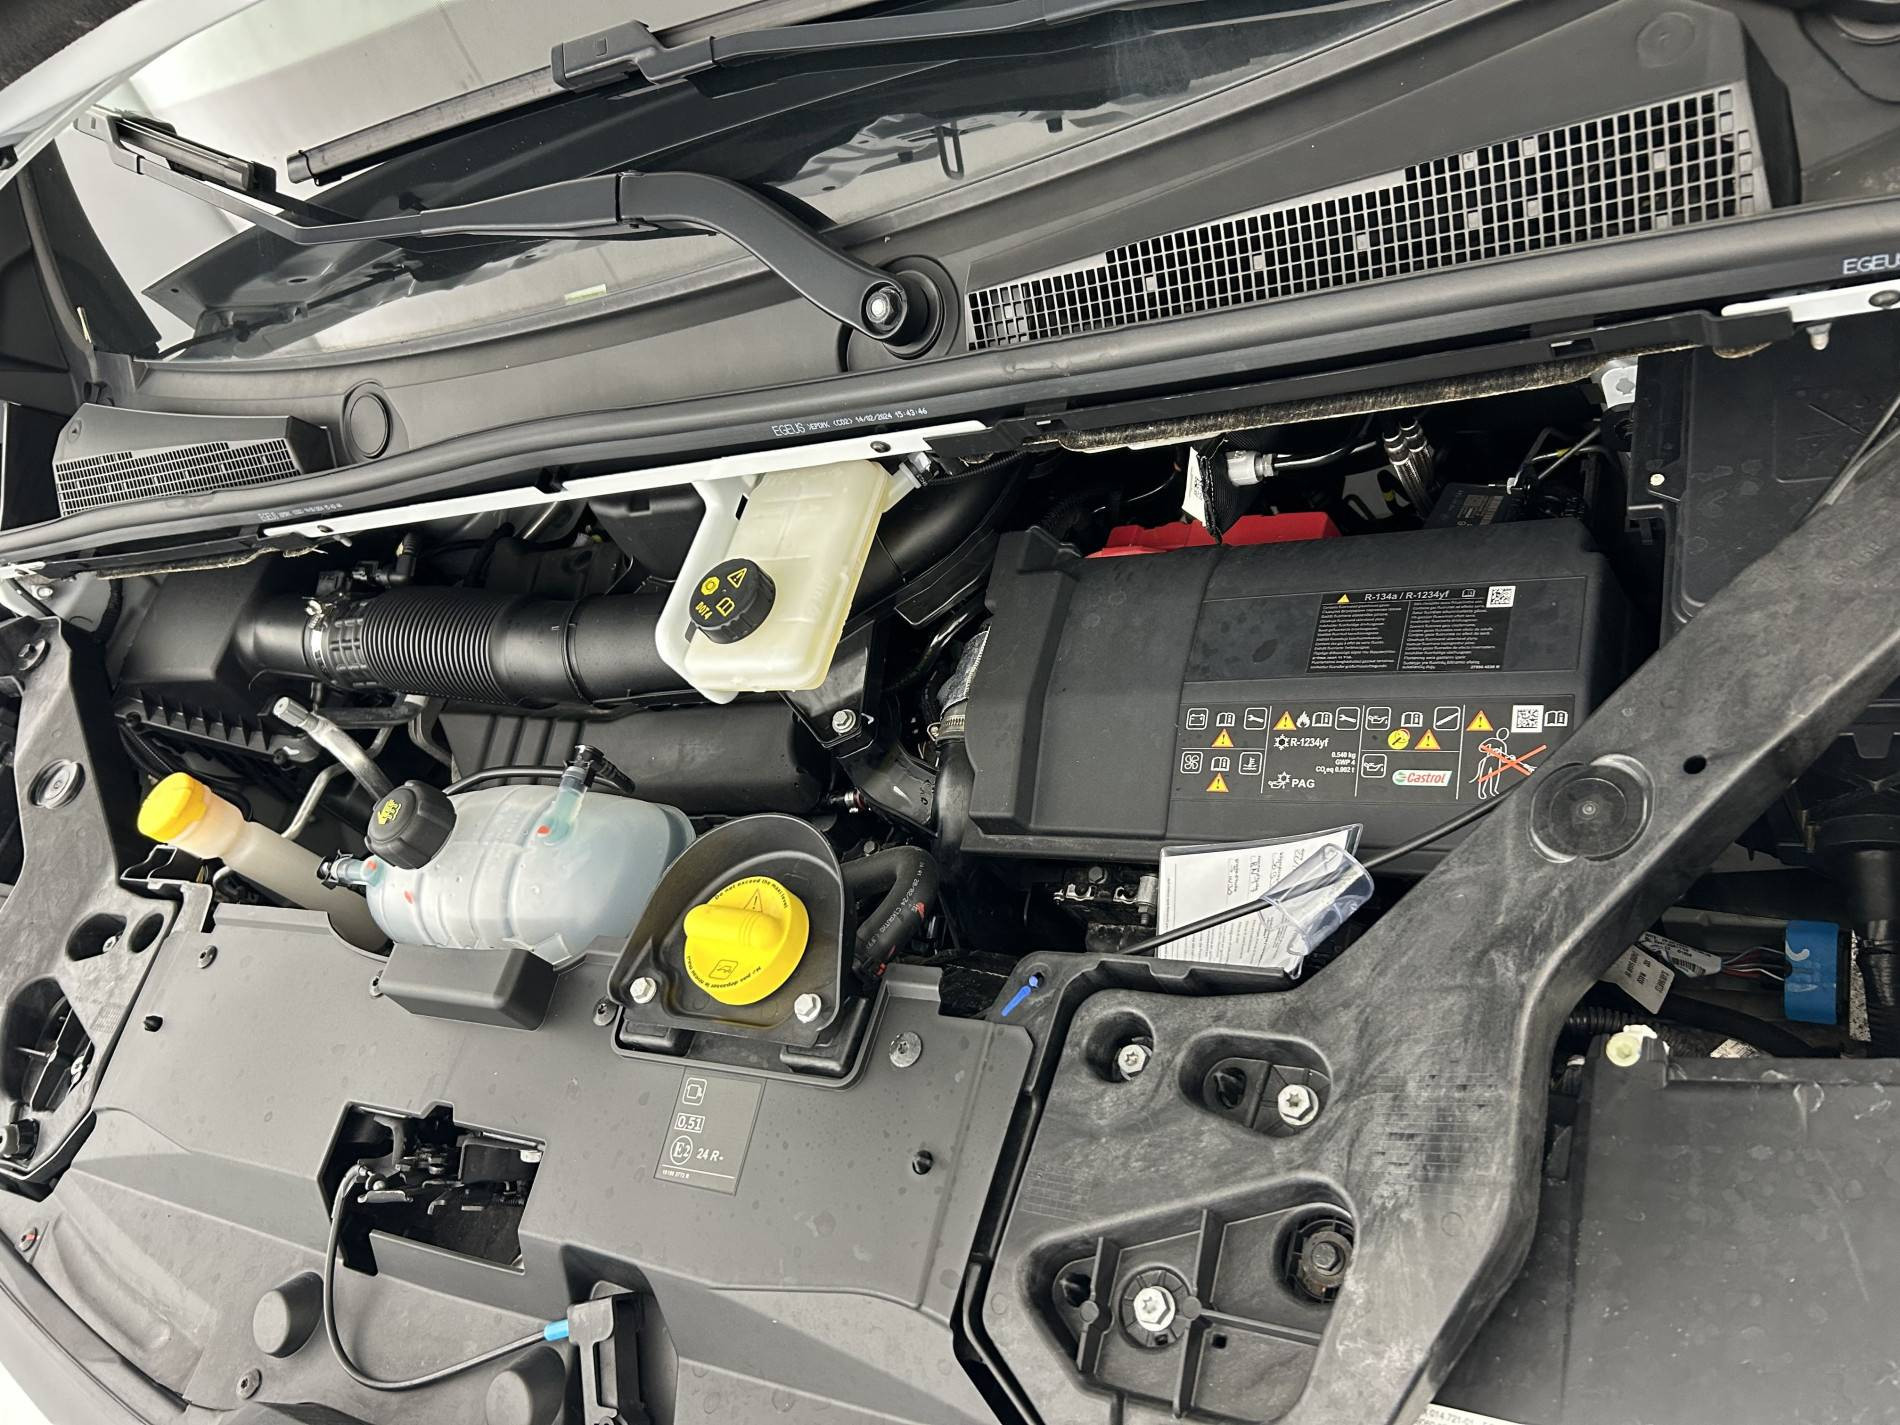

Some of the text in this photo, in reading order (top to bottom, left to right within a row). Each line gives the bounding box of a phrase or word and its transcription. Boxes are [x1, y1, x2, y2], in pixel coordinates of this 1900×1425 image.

[1365, 593, 1398, 601] R-134a
[1406, 590, 1450, 600] R-1234yf
[1290, 737, 1328, 748] R-1234yf
[1291, 779, 1315, 788] PAG
[1407, 772, 1447, 784] Castrol
[678, 1115, 702, 1131] 0,51
[673, 1141, 691, 1158] E2
[696, 1147, 710, 1160] 24
